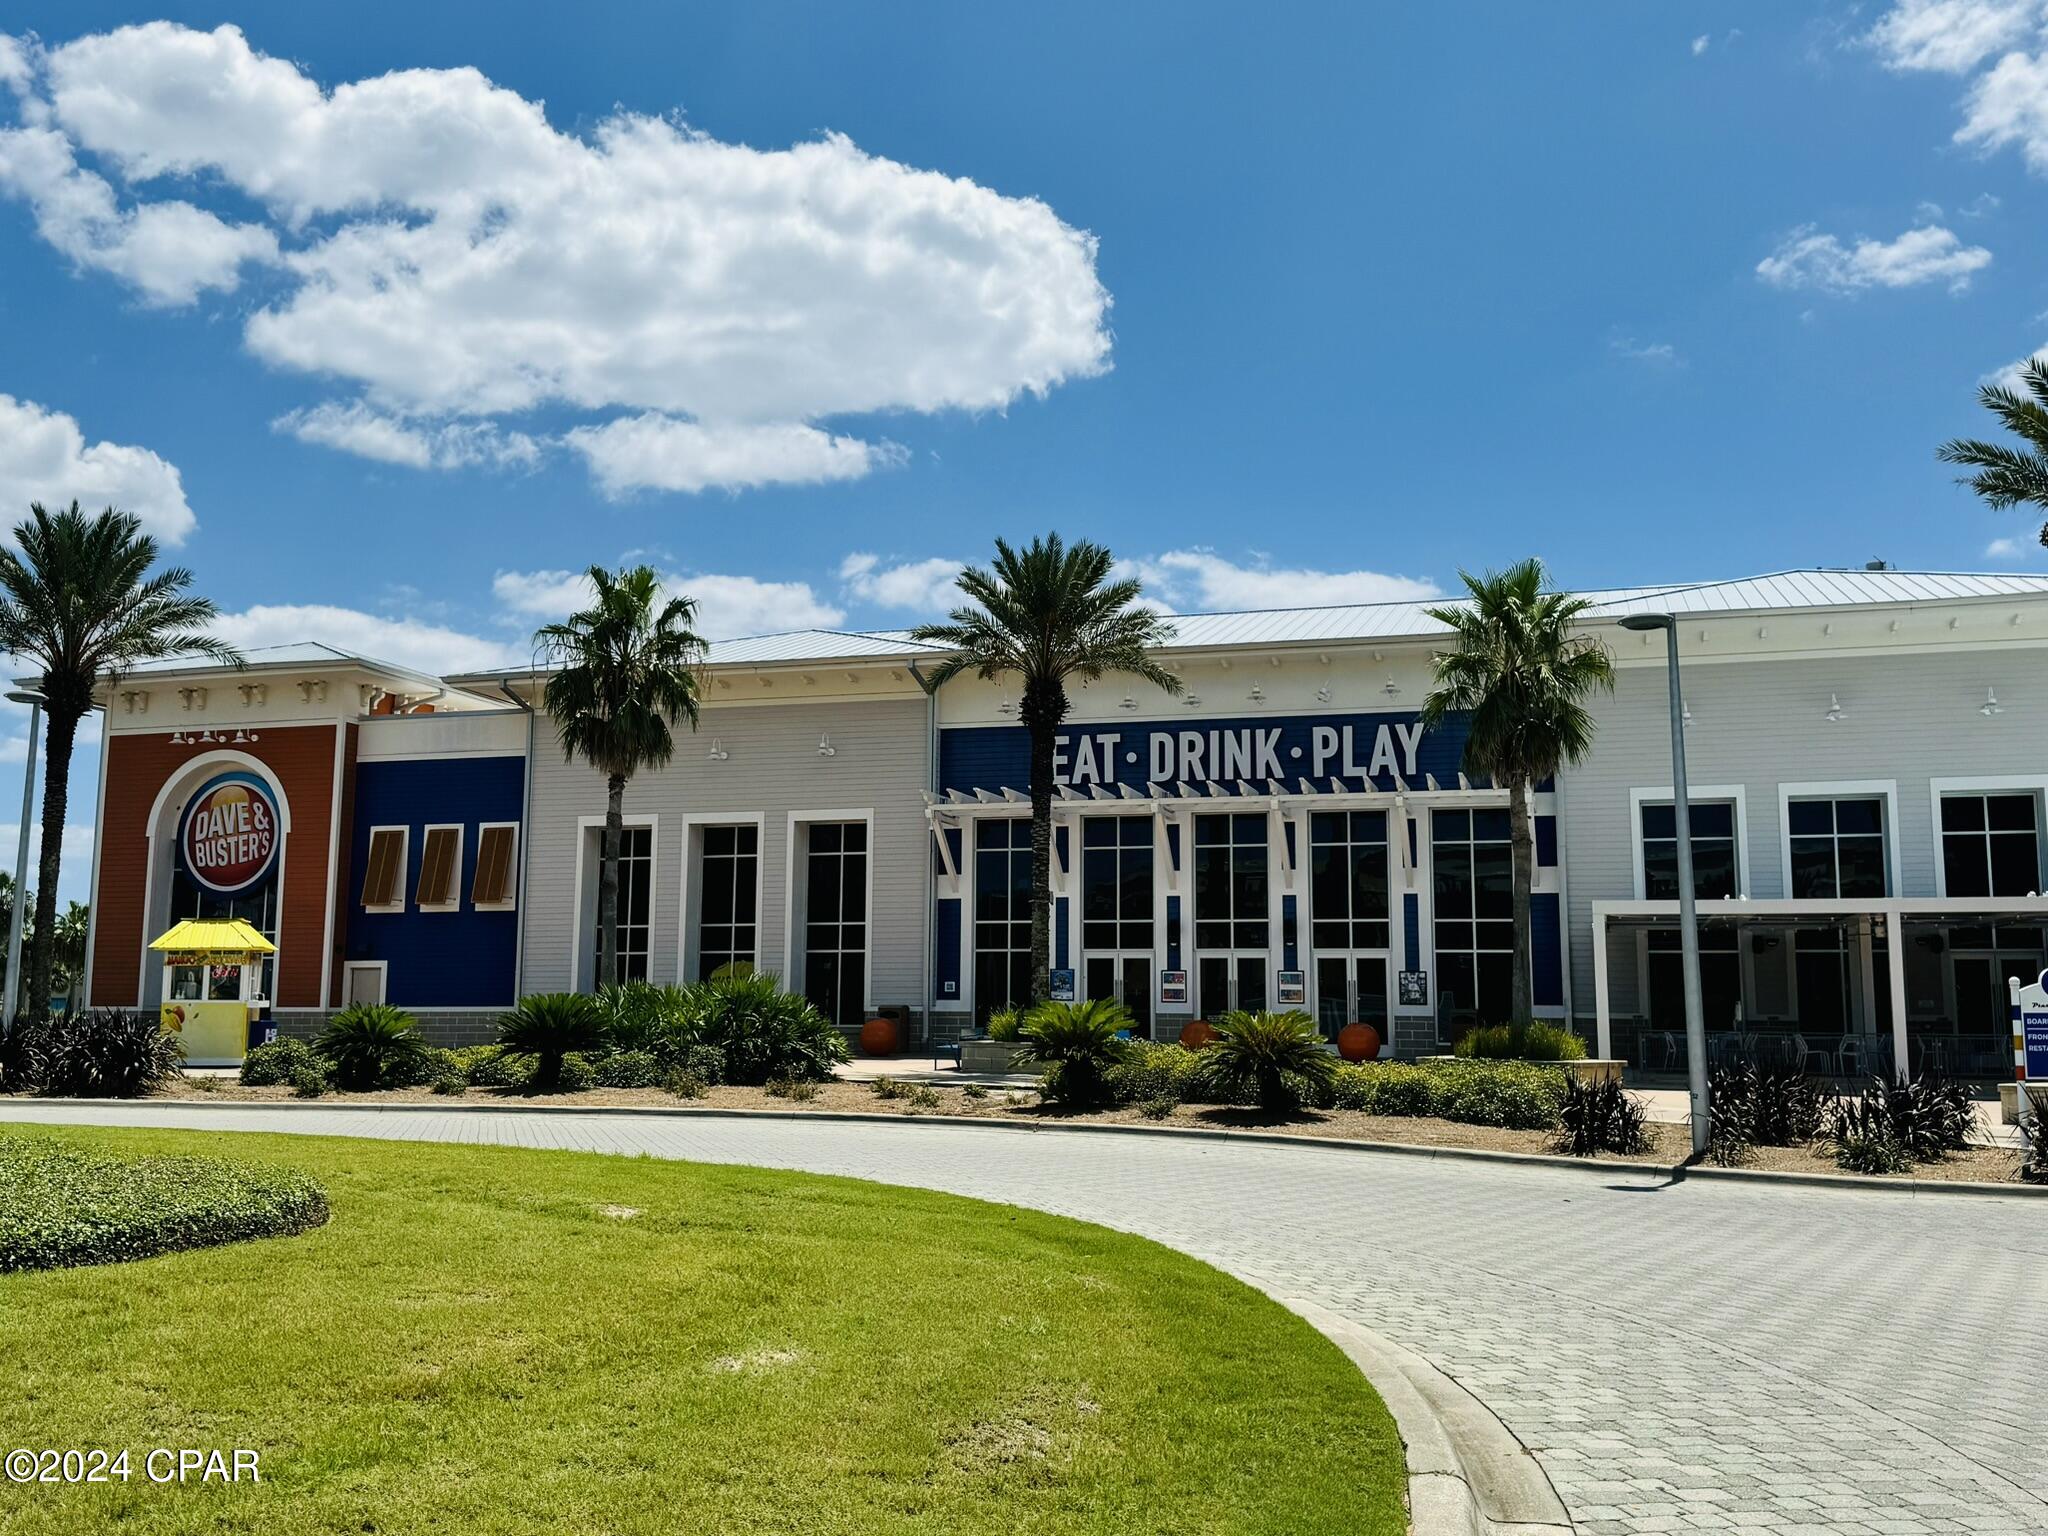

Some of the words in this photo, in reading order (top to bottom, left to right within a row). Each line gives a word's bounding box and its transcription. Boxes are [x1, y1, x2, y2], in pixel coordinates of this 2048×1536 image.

[1052, 733, 1121, 785] EAT
[1149, 728, 1285, 782] DRINK
[1312, 723, 1424, 778] PLAY
[195, 802, 251, 841] DAVE
[253, 802, 269, 830] &
[195, 831, 270, 867] BUSTER'S
